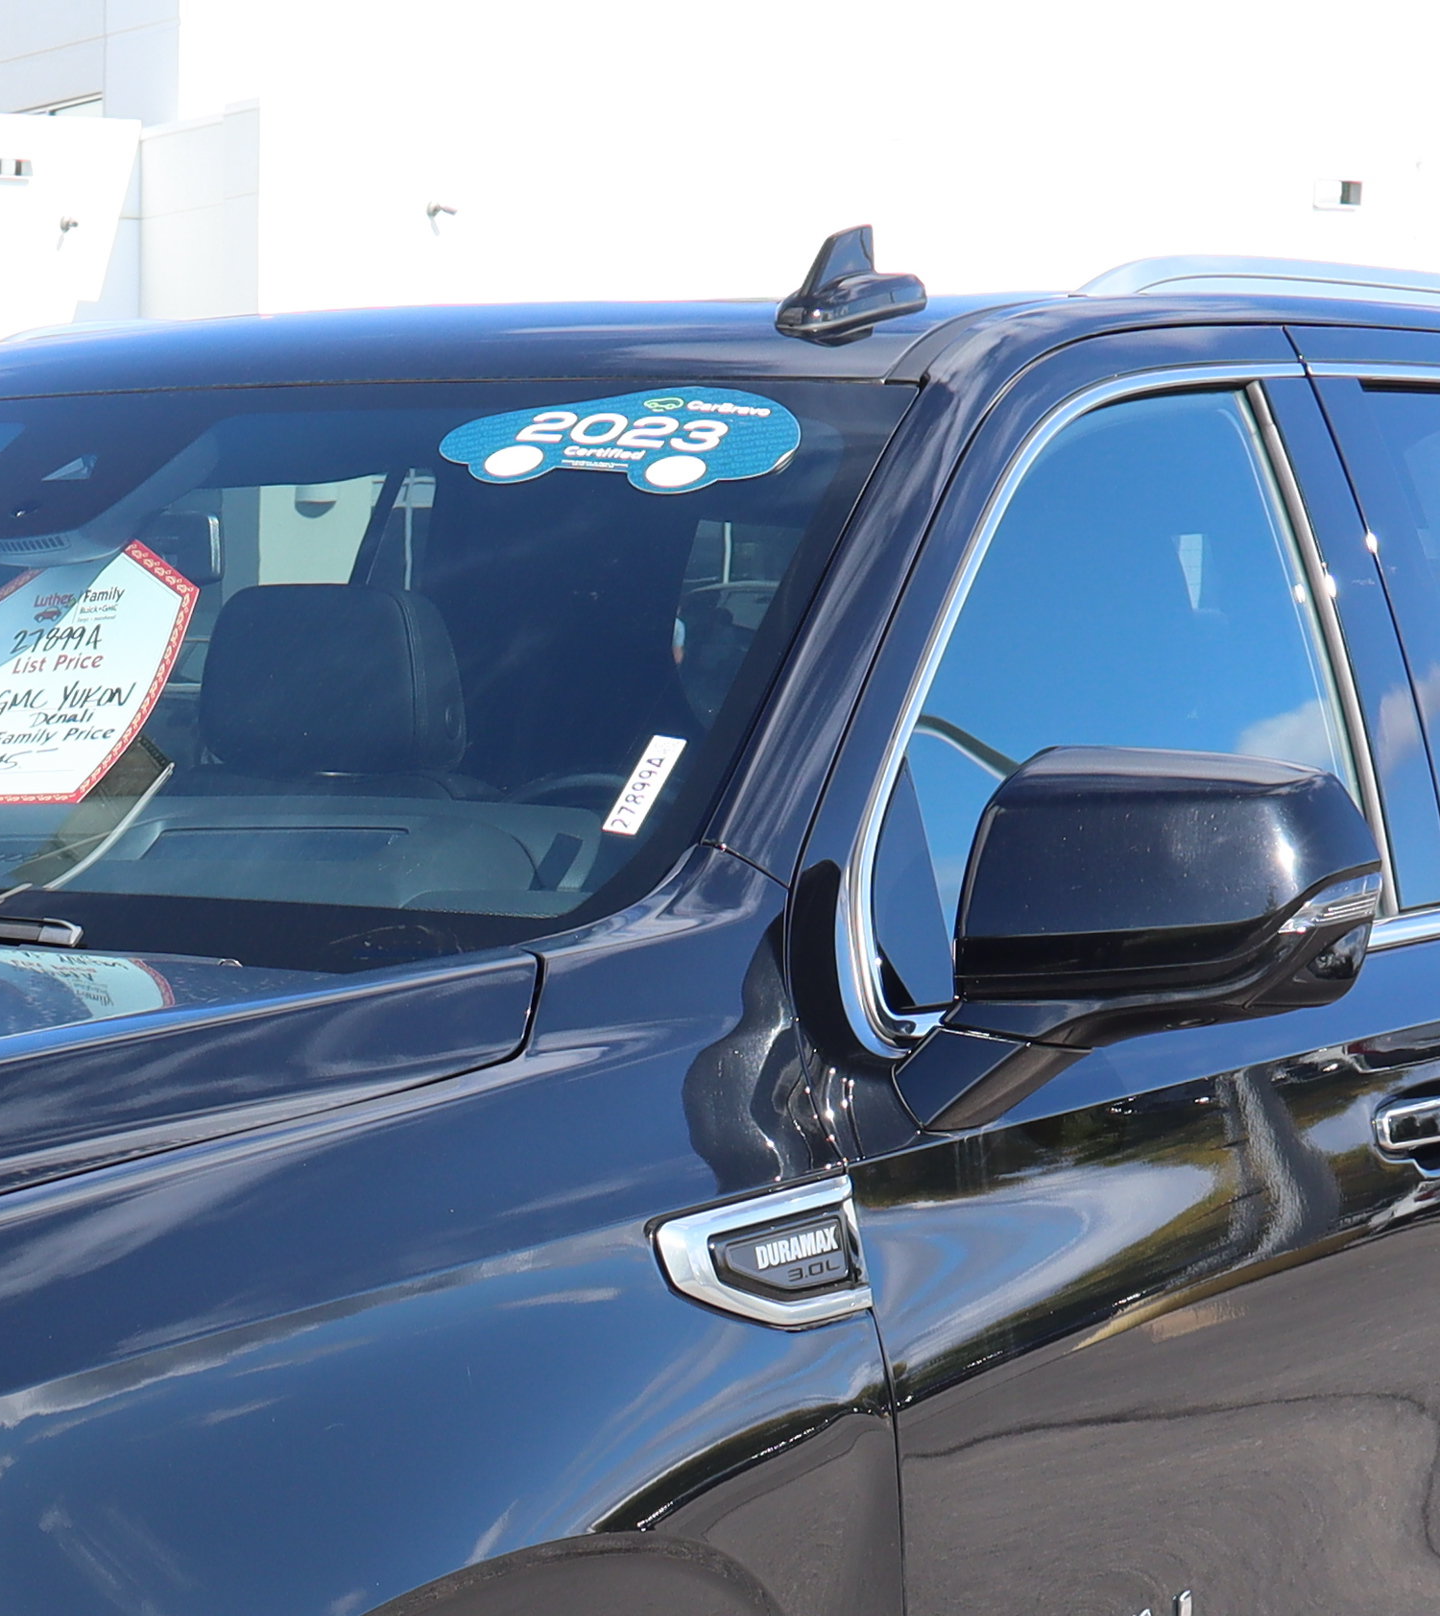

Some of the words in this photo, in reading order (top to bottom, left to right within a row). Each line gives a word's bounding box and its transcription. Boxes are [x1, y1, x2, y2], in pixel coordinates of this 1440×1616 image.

[687, 400, 771, 417] CarBravo
[515, 411, 729, 452] 2023
[564, 446, 646, 460] Certified
[33, 592, 74, 608] Luther
[83, 586, 126, 603] Family
[9, 623, 103, 655] 27899A
[11, 656, 47, 675] List
[52, 652, 104, 673] Price
[57, 680, 137, 712] YUKON
[29, 707, 96, 729] Denali
[62, 726, 116, 743] Price
[610, 757, 666, 829] 27899A
[755, 1224, 839, 1270] DURAMAX
[787, 1259, 841, 1282] 3.0L
